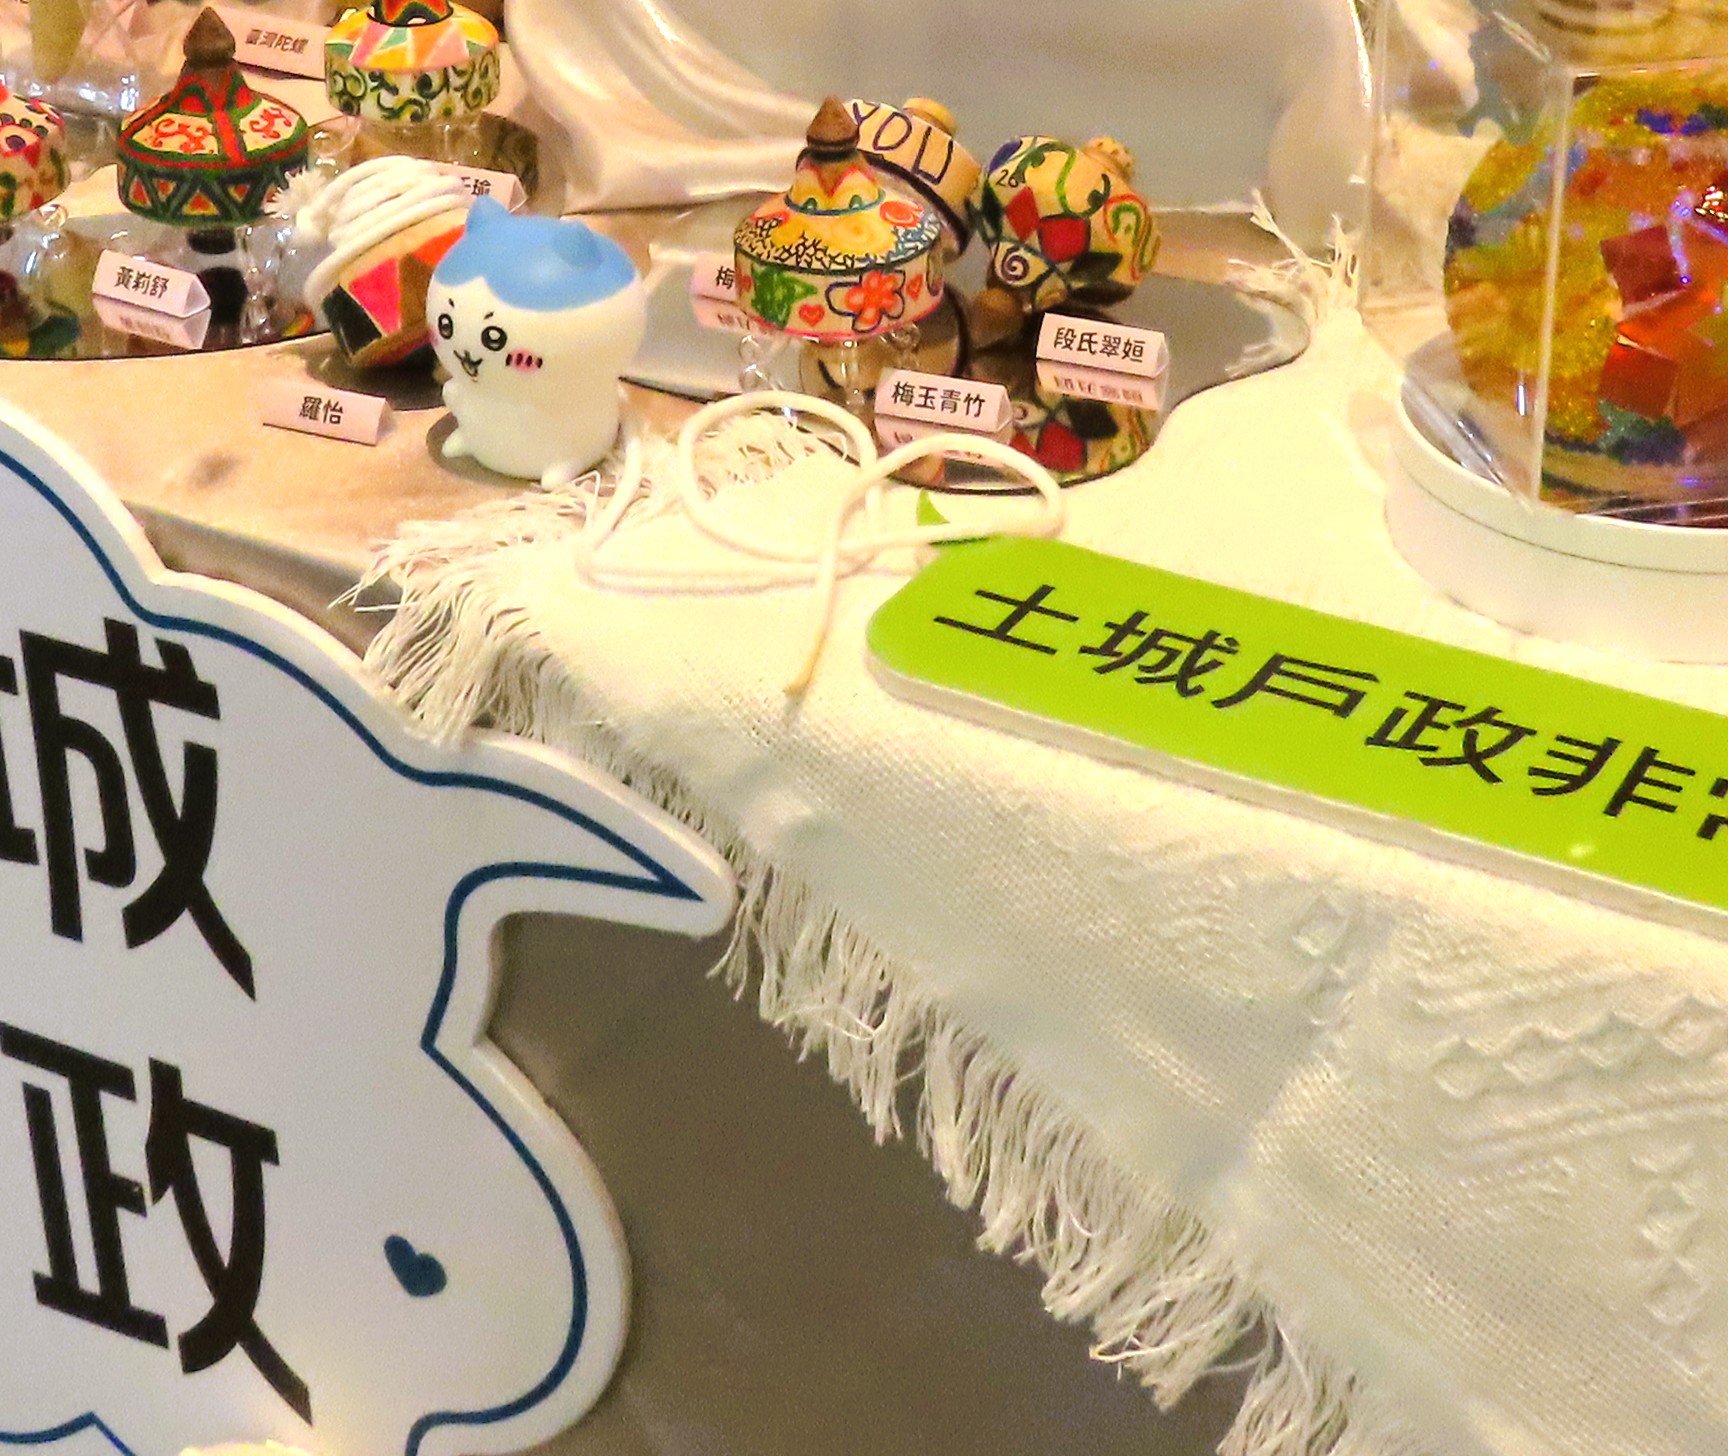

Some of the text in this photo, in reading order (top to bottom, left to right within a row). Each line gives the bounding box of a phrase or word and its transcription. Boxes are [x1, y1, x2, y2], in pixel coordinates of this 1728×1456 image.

[852, 100, 955, 184] YOU
[890, 380, 986, 418] 梅玉青竹
